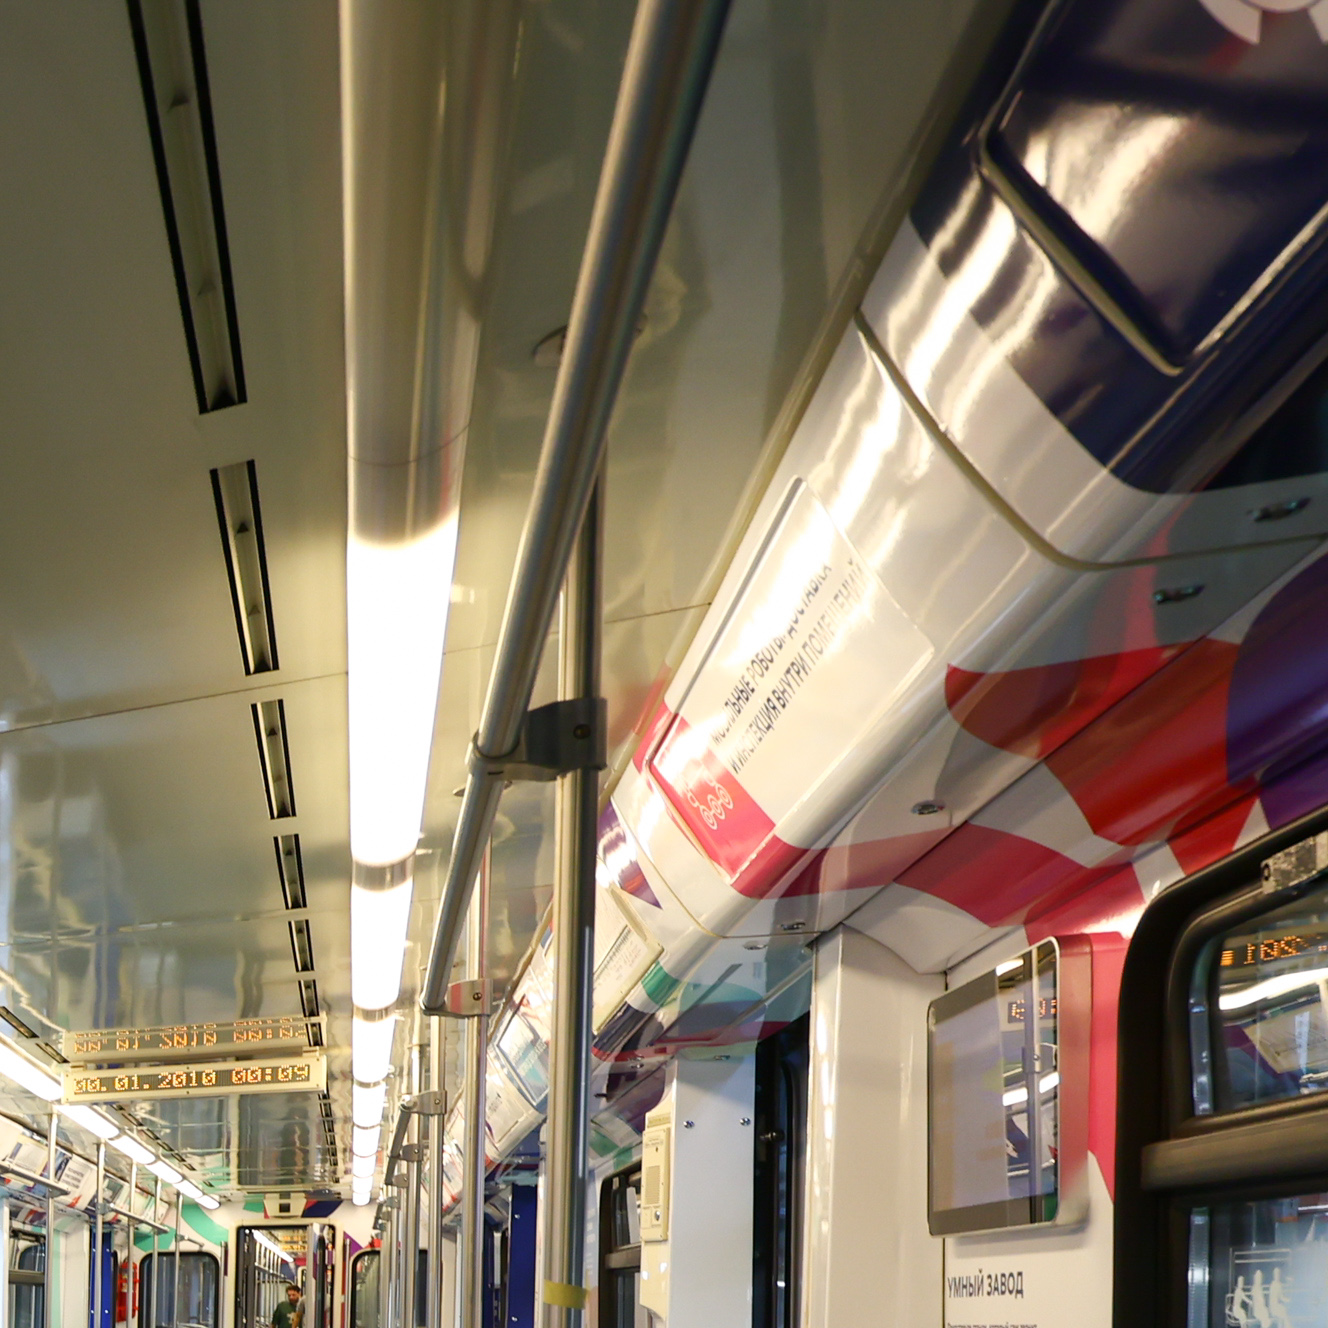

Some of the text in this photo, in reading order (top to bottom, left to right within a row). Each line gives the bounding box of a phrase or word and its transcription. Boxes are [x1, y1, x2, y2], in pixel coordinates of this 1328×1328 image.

[771, 651, 813, 709] ВНУТРИ
[947, 1268, 1025, 1299] УМНЫЙ ЗАВОД
